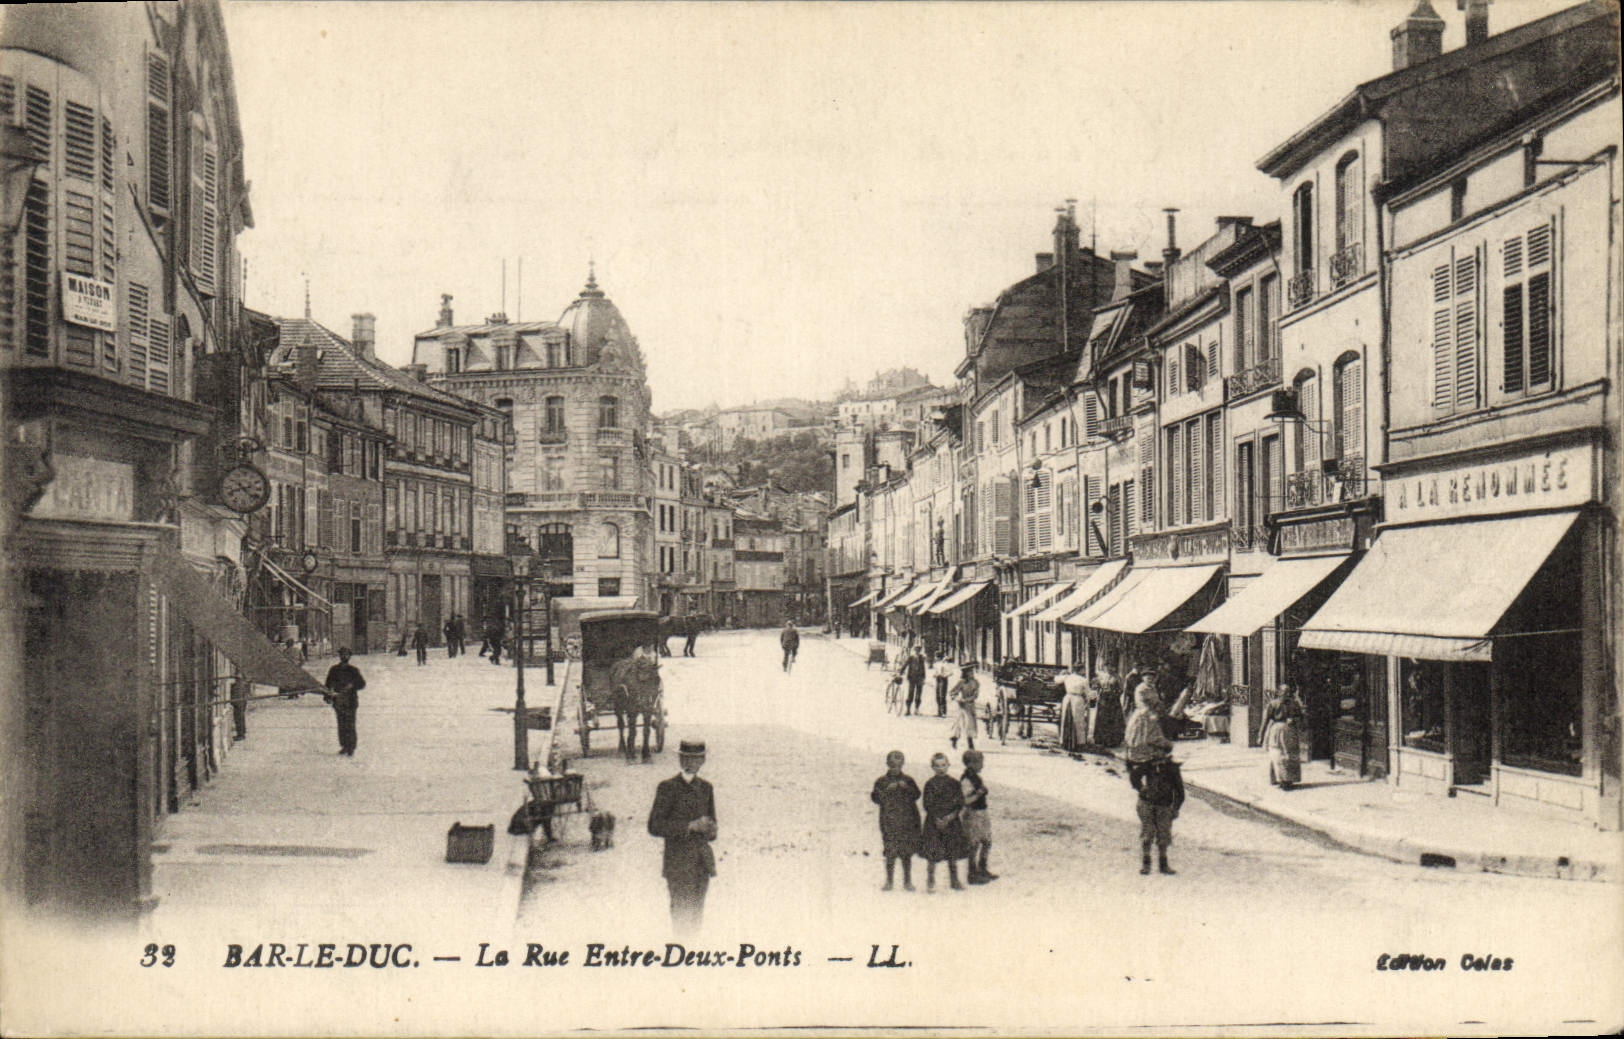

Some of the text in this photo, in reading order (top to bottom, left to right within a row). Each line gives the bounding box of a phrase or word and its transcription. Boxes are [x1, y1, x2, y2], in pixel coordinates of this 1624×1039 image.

[68, 277, 110, 301] MAISON
[1399, 482, 1408, 510] A
[1417, 478, 1440, 507] LA
